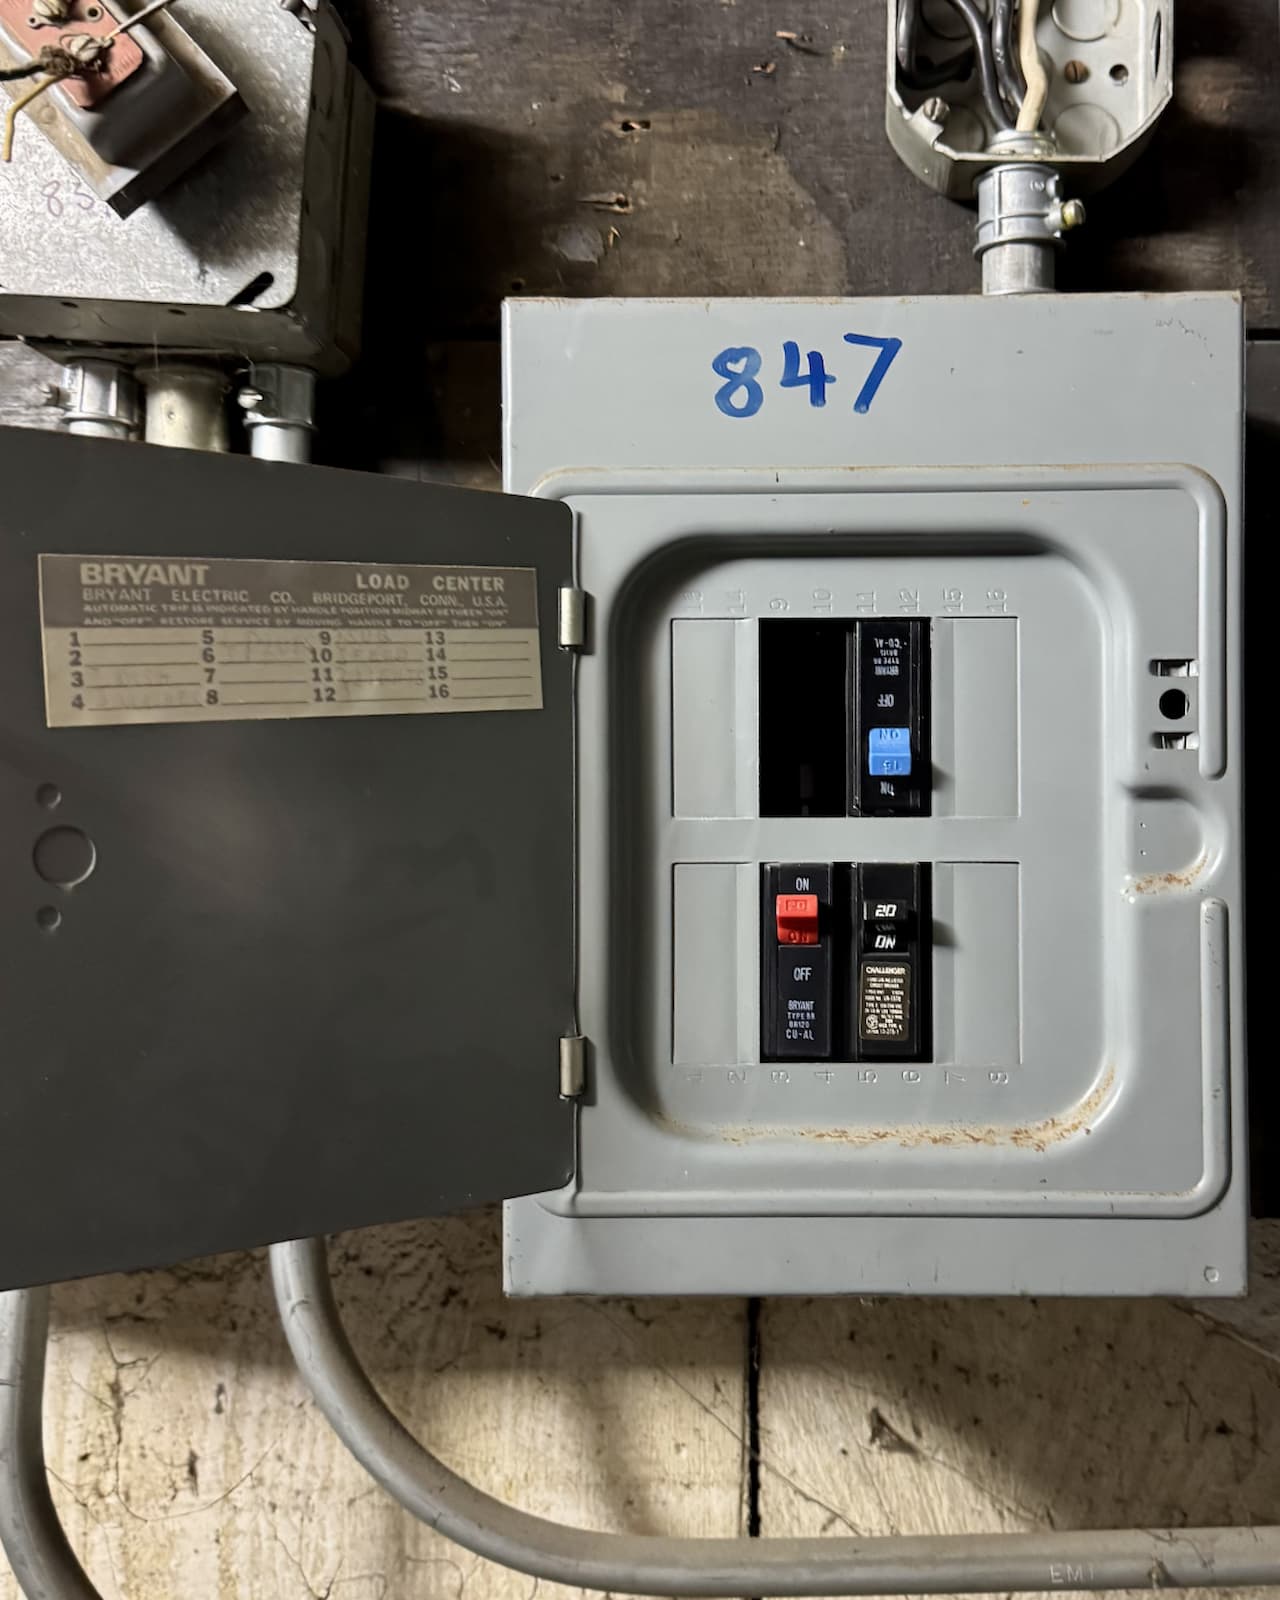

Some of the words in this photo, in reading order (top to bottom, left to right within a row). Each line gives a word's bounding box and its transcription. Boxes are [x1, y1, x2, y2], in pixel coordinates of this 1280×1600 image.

[711, 332, 903, 418] 847
[80, 562, 210, 586] BRYANT
[355, 573, 410, 591] LOAD
[431, 575, 505, 592] CENTER
[83, 588, 153, 602] BRYANT
[171, 588, 249, 602] ELECTRIC
[269, 591, 296, 604] CO.
[312, 591, 409, 606] BRIDGEPORT,
[83, 603, 158, 614] AUTOMATIC
[161, 604, 189, 613] TRIP
[69, 630, 82, 648] 1
[202, 629, 214, 645] 5
[319, 631, 331, 646] 9
[424, 631, 446, 646] 13
[68, 650, 83, 667] 2
[202, 647, 215, 663] 6
[310, 648, 333, 664] 10
[425, 647, 447, 662] 14
[70, 670, 84, 688] 3
[203, 667, 216, 684] 7
[311, 666, 334, 682] 11
[427, 665, 449, 680] 15
[205, 689, 219, 705] 8
[313, 686, 337, 703] 12
[428, 683, 450, 699] 16
[71, 693, 86, 712] 4
[876, 693, 895, 708] OFF
[795, 877, 810, 891] ON
[874, 903, 898, 918] 20
[874, 935, 896, 950] ON
[793, 966, 812, 981] OFF
[865, 966, 907, 975] CHALLENGER
[787, 1000, 815, 1011] BRYANT
[787, 1012, 805, 1020] TYPE
[785, 1028, 815, 1041] CU-AL
